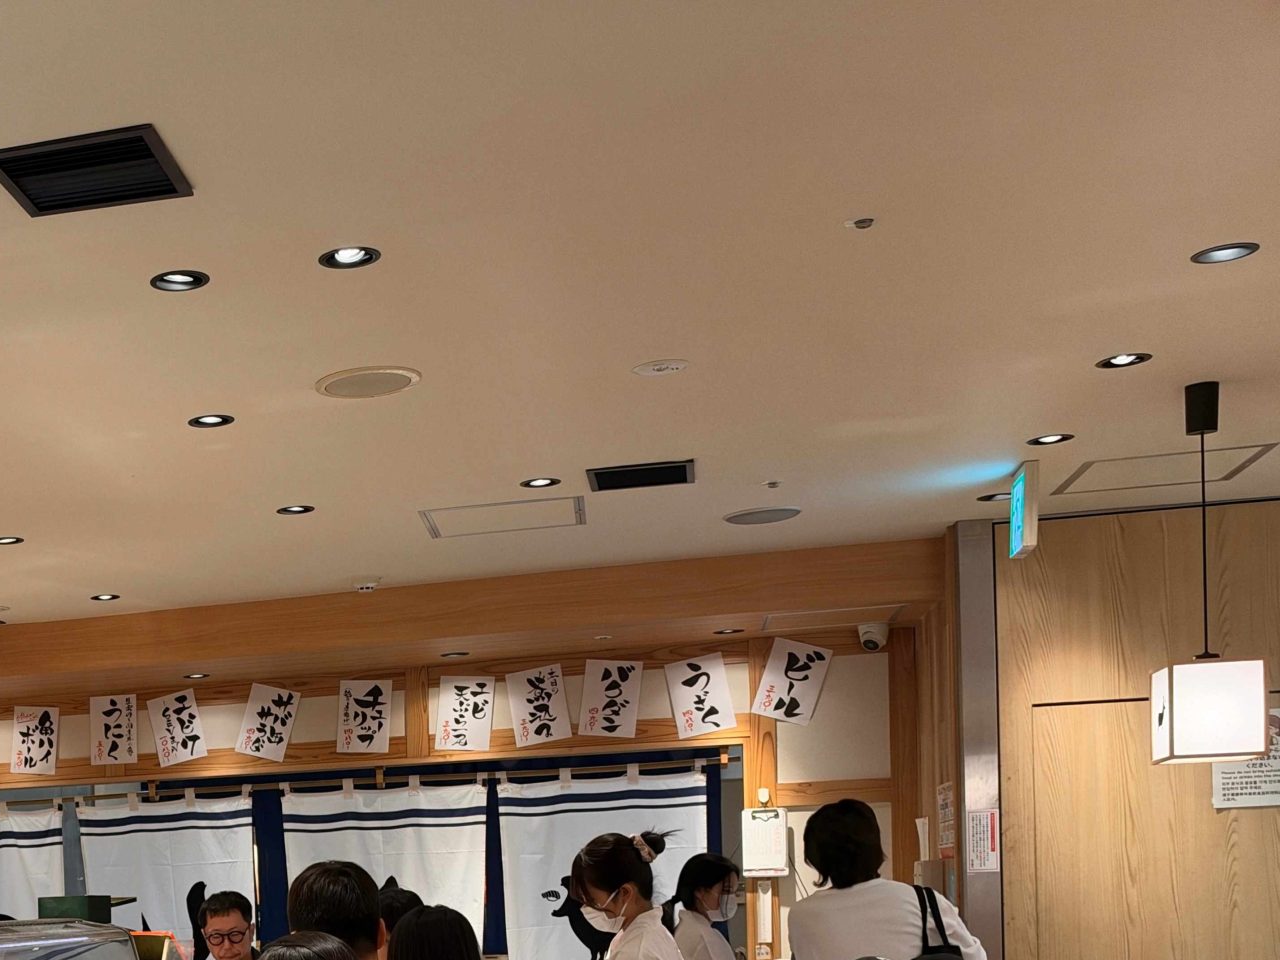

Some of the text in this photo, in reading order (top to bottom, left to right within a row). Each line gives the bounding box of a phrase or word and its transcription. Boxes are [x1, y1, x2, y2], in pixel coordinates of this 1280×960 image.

[681, 662, 721, 728] うざく
[773, 650, 826, 718] ビール
[101, 698, 124, 761] うにく
